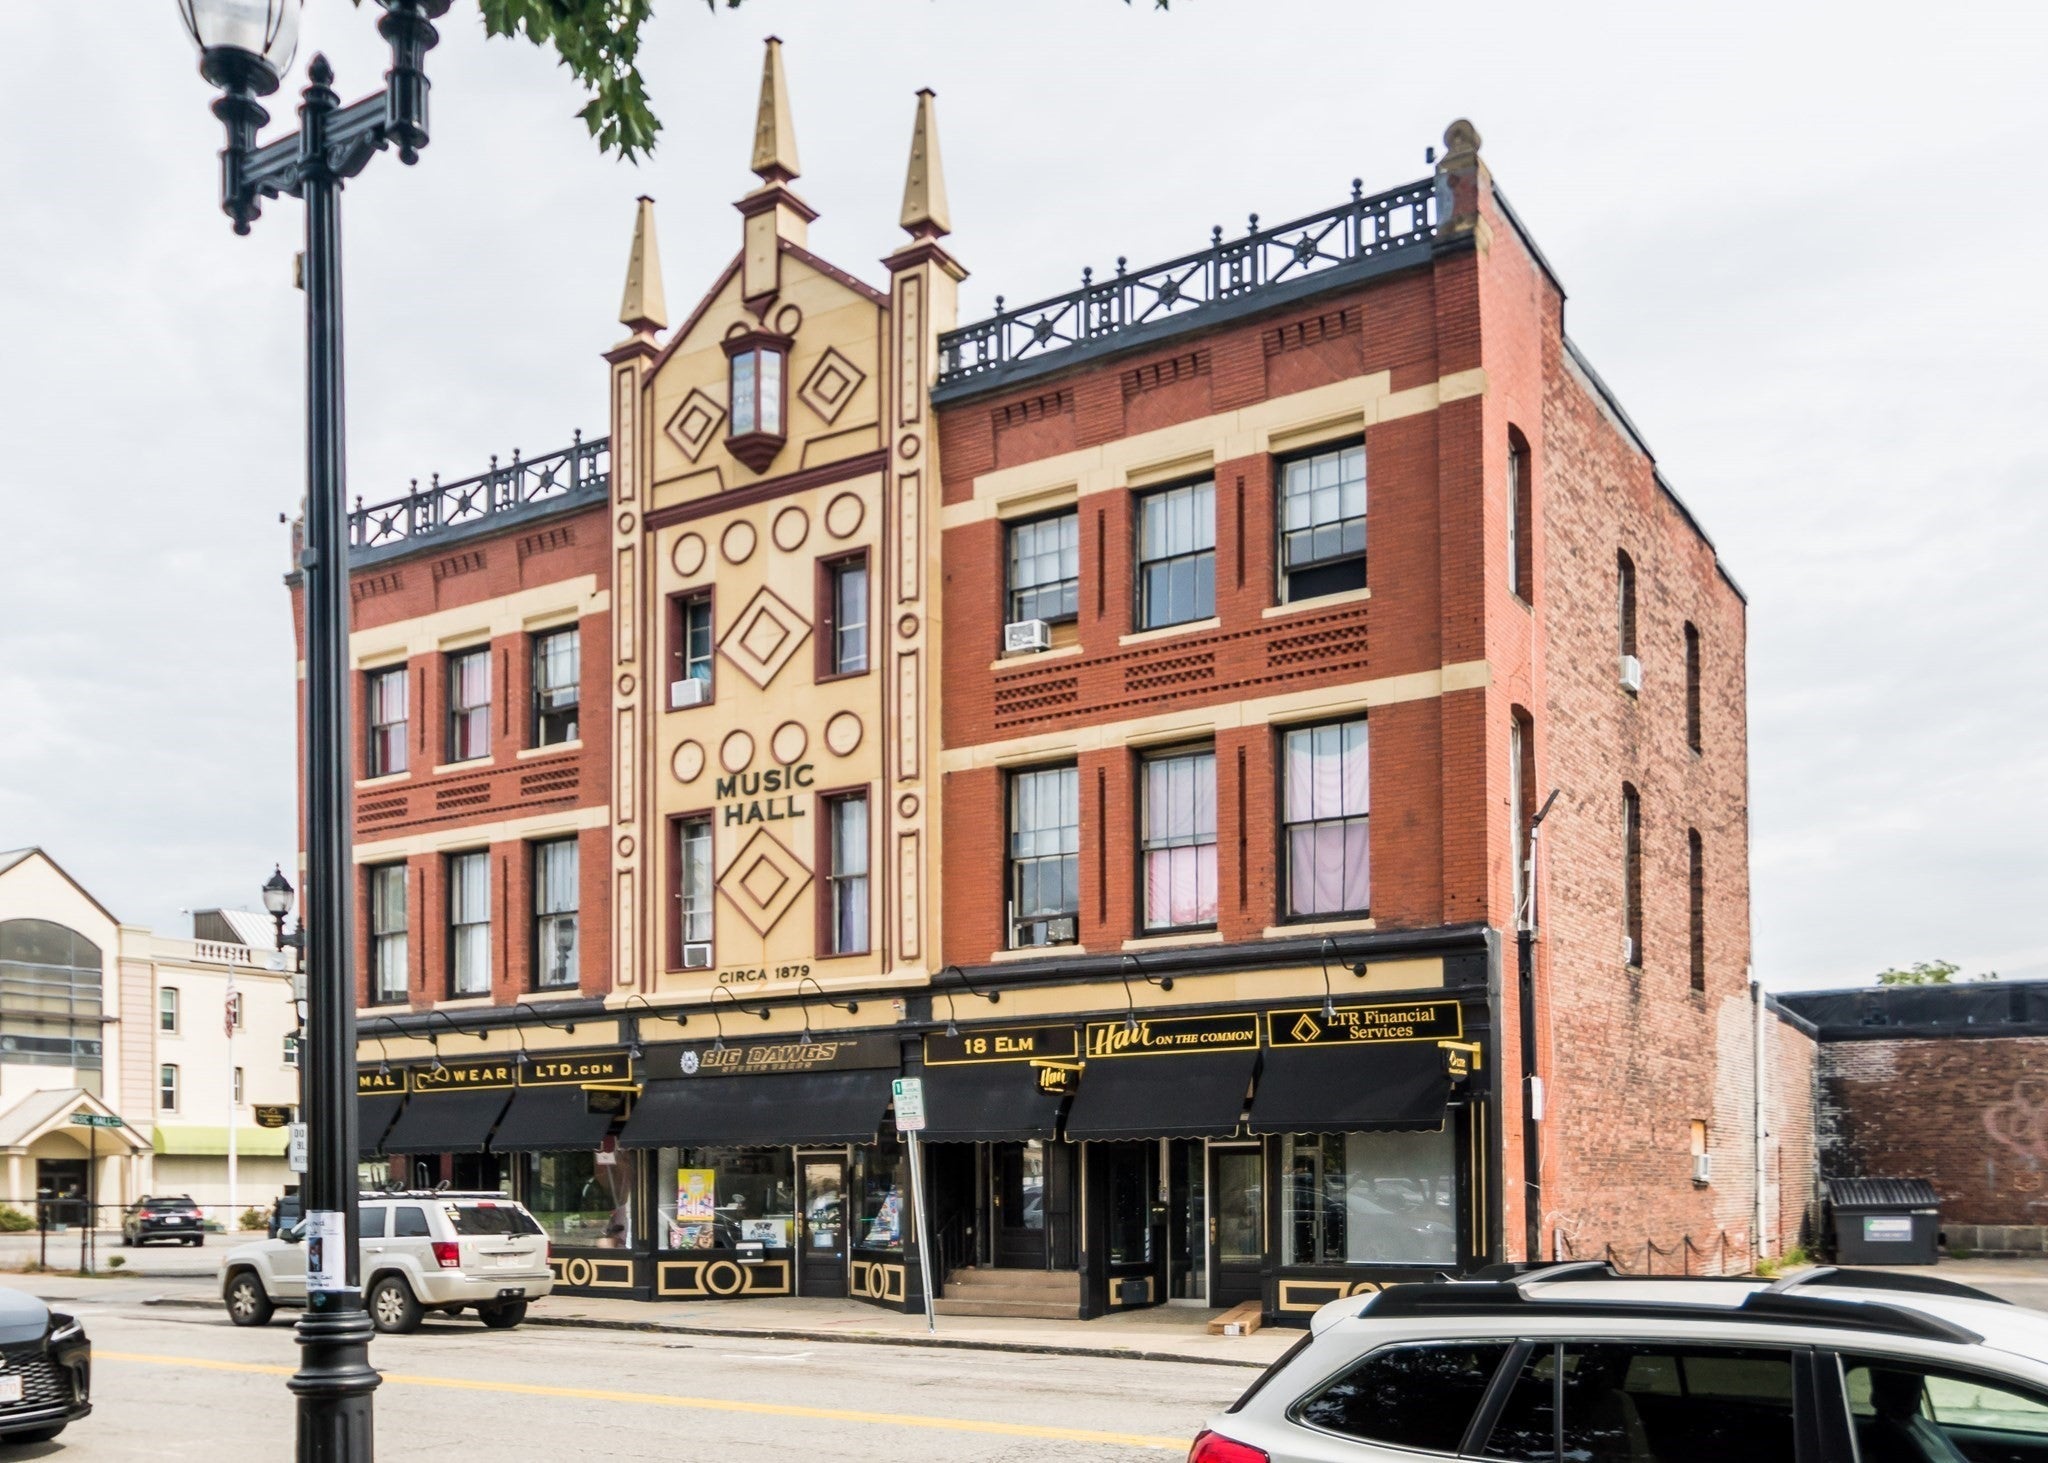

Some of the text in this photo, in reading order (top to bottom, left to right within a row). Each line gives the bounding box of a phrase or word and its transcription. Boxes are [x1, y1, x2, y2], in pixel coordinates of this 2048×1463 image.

[716, 763, 814, 800] MUSIC
[724, 795, 806, 826] HALL
[719, 964, 810, 984] CIRCA 1879
[1327, 1007, 1436, 1026] LTR Financial
[1094, 1022, 1254, 1054] Hair ON THE COMMON
[1349, 1024, 1414, 1039] Services
[700, 1042, 838, 1067] BIG DAWGS
[964, 1037, 1034, 1054] 18 ELM
[359, 1074, 396, 1087] MAL
[453, 1067, 508, 1082] WEAR
